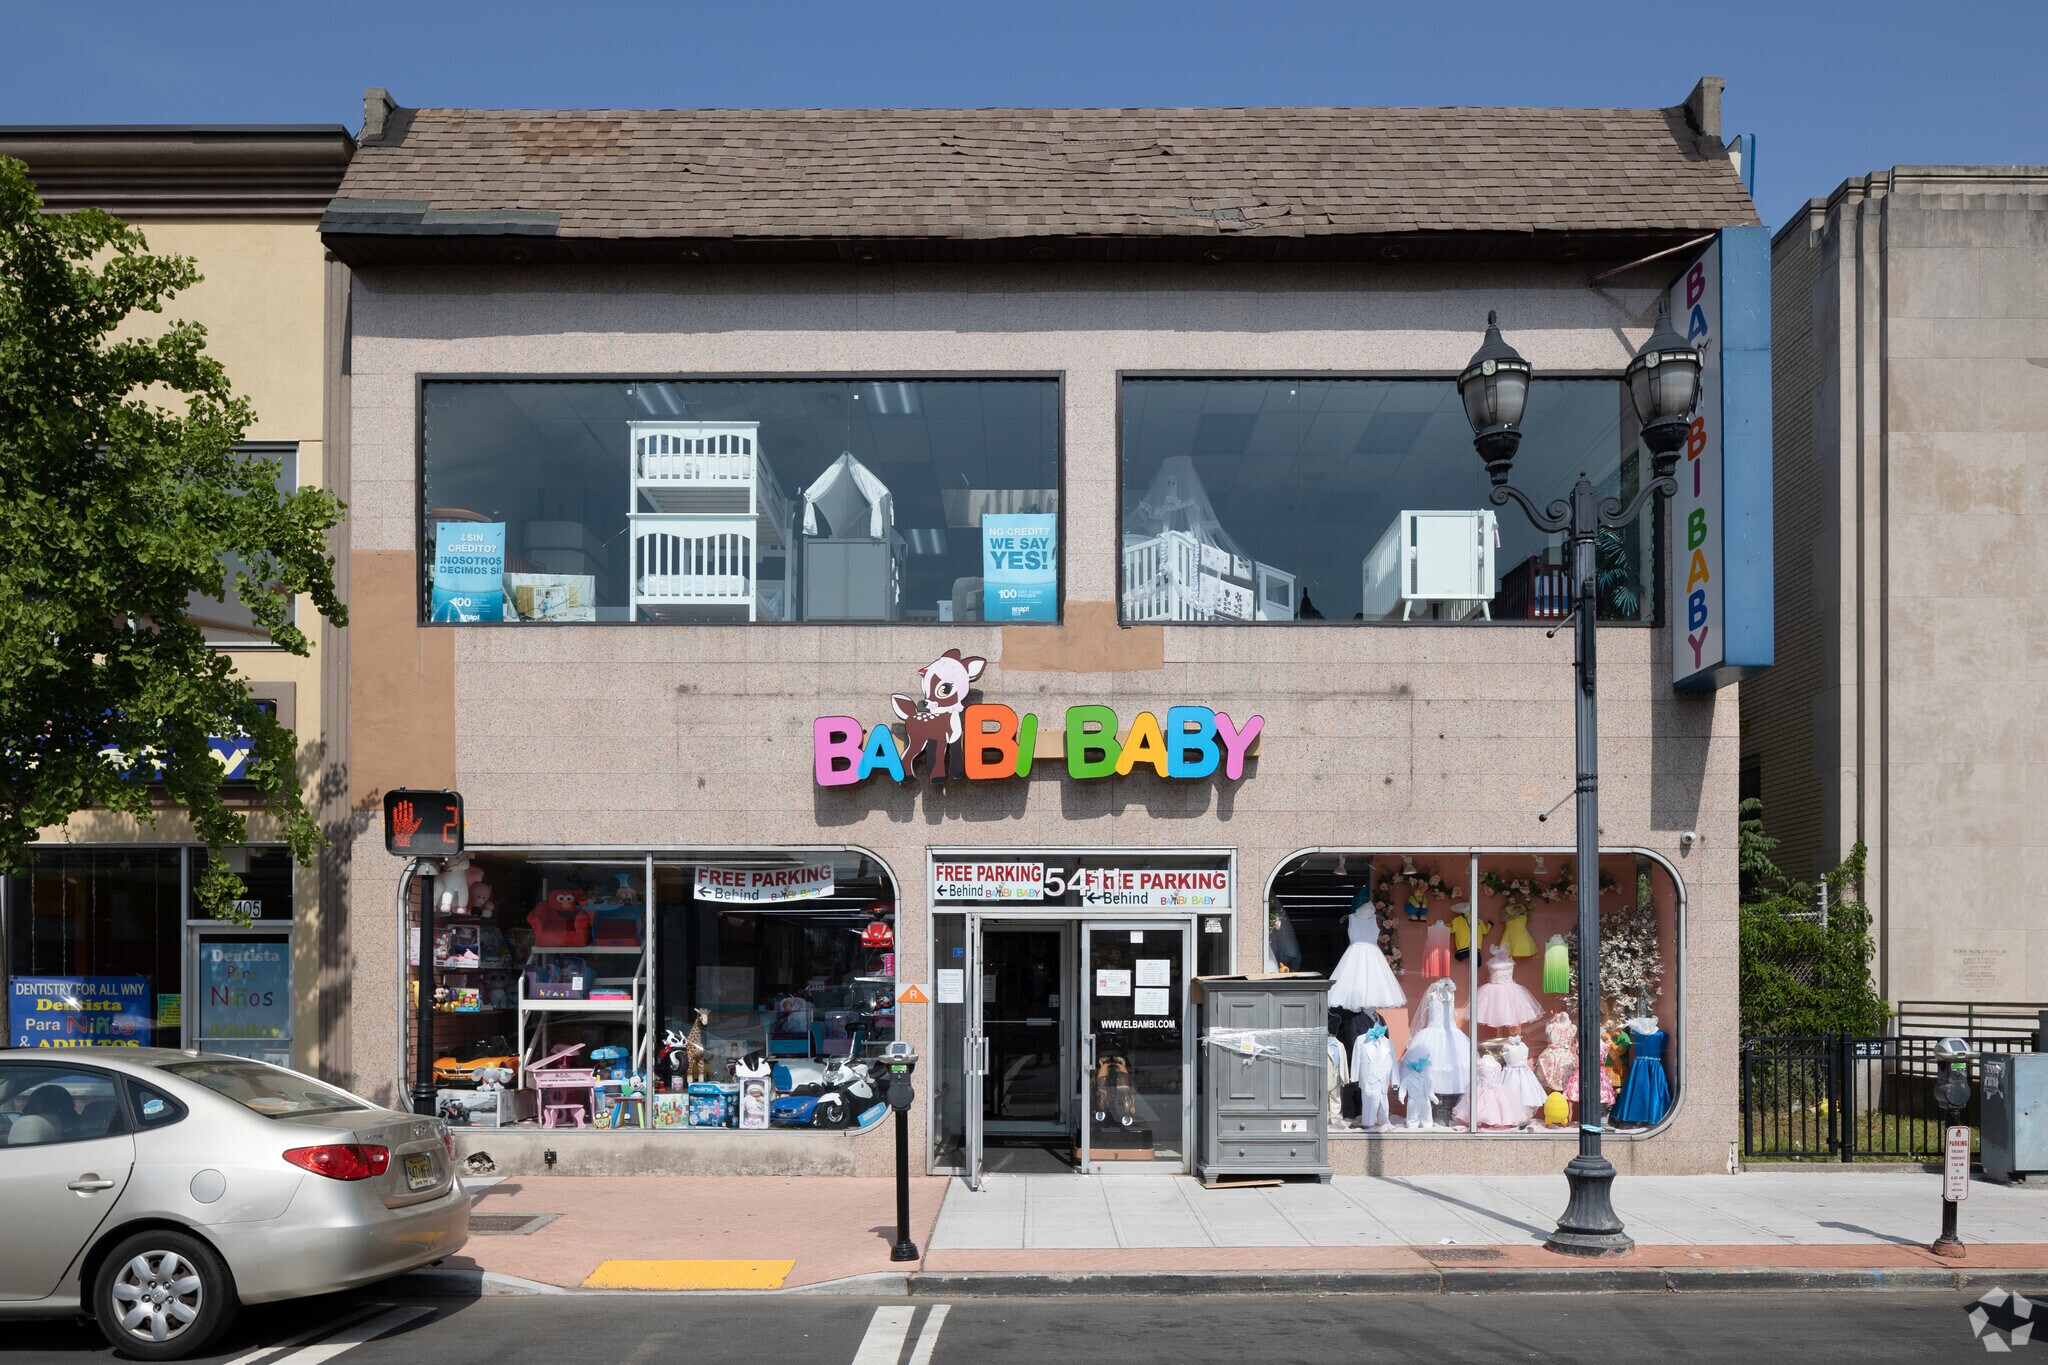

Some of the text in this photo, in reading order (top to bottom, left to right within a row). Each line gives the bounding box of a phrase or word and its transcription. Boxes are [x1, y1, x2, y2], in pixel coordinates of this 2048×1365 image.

[1686, 260, 1709, 498] BABI
[461, 533, 483, 542] ¿SIN
[989, 528, 1050, 536] NO CREDIT?
[448, 543, 497, 553] CRÉDITO?
[990, 538, 1049, 549] WE SAY
[440, 556, 502, 566] ¡NOSOTROS
[990, 551, 1048, 570] YES!
[440, 566, 488, 574] DECIMOS
[998, 589, 1017, 598] 100
[1687, 508, 1709, 669] BABY
[1012, 606, 1029, 614] snap!
[1065, 704, 1266, 780] BABY
[442, 806, 458, 843] 2
[697, 864, 832, 887] FREE PARKING
[936, 865, 1041, 882] FREE PARKING
[1044, 868, 1120, 897] 5411
[1086, 873, 1226, 890] FRE PARKING
[715, 887, 760, 900] Behind
[949, 884, 983, 897] Behind
[1016, 888, 1040, 897] BABY
[1103, 892, 1148, 905] Behind
[1191, 896, 1216, 905] BABY
[233, 901, 260, 917] 405
[211, 949, 280, 962] Dentista
[227, 965, 257, 981] Para
[16, 983, 144, 995] DENTISTRY FOR ALL WNY
[909, 989, 918, 999] R
[211, 985, 273, 1008] Niños
[36, 998, 122, 1011] Dentista
[25, 1015, 136, 1035] Para Niños
[208, 1023, 281, 1038] Adultos
[1101, 1020, 1175, 1028] WWW.ELBAMBI.COM
